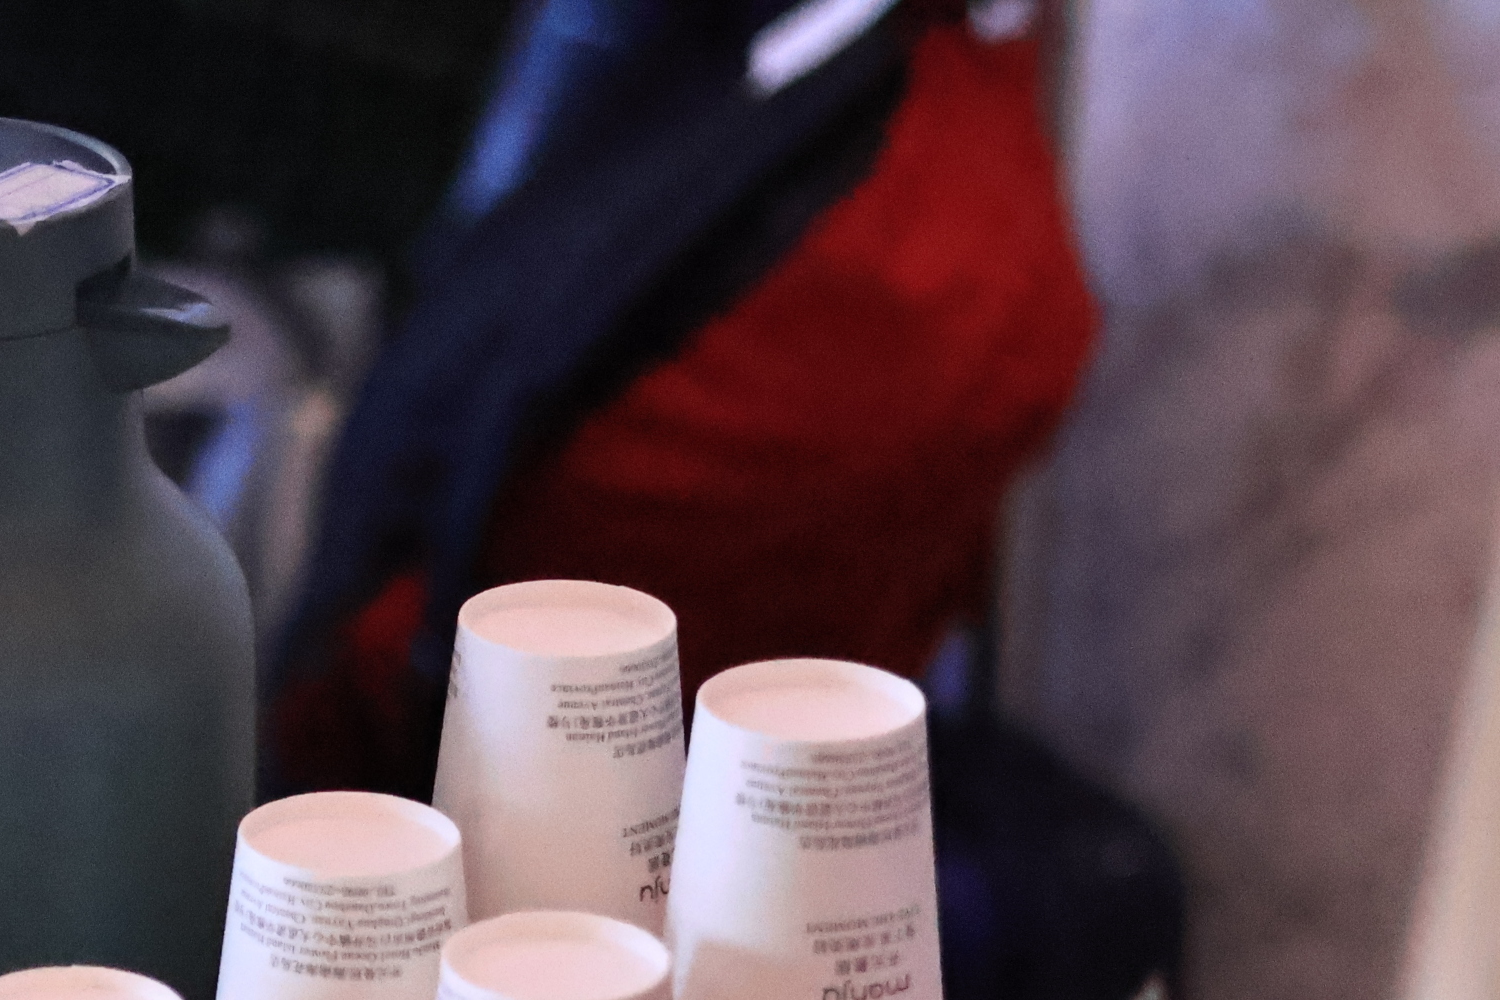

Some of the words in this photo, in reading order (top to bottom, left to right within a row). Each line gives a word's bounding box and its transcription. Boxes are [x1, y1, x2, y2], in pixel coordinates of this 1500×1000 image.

[557, 700, 599, 712] Avenue
[640, 875, 671, 905] nju
[266, 937, 296, 957] Island
[299, 947, 339, 963] Flower
